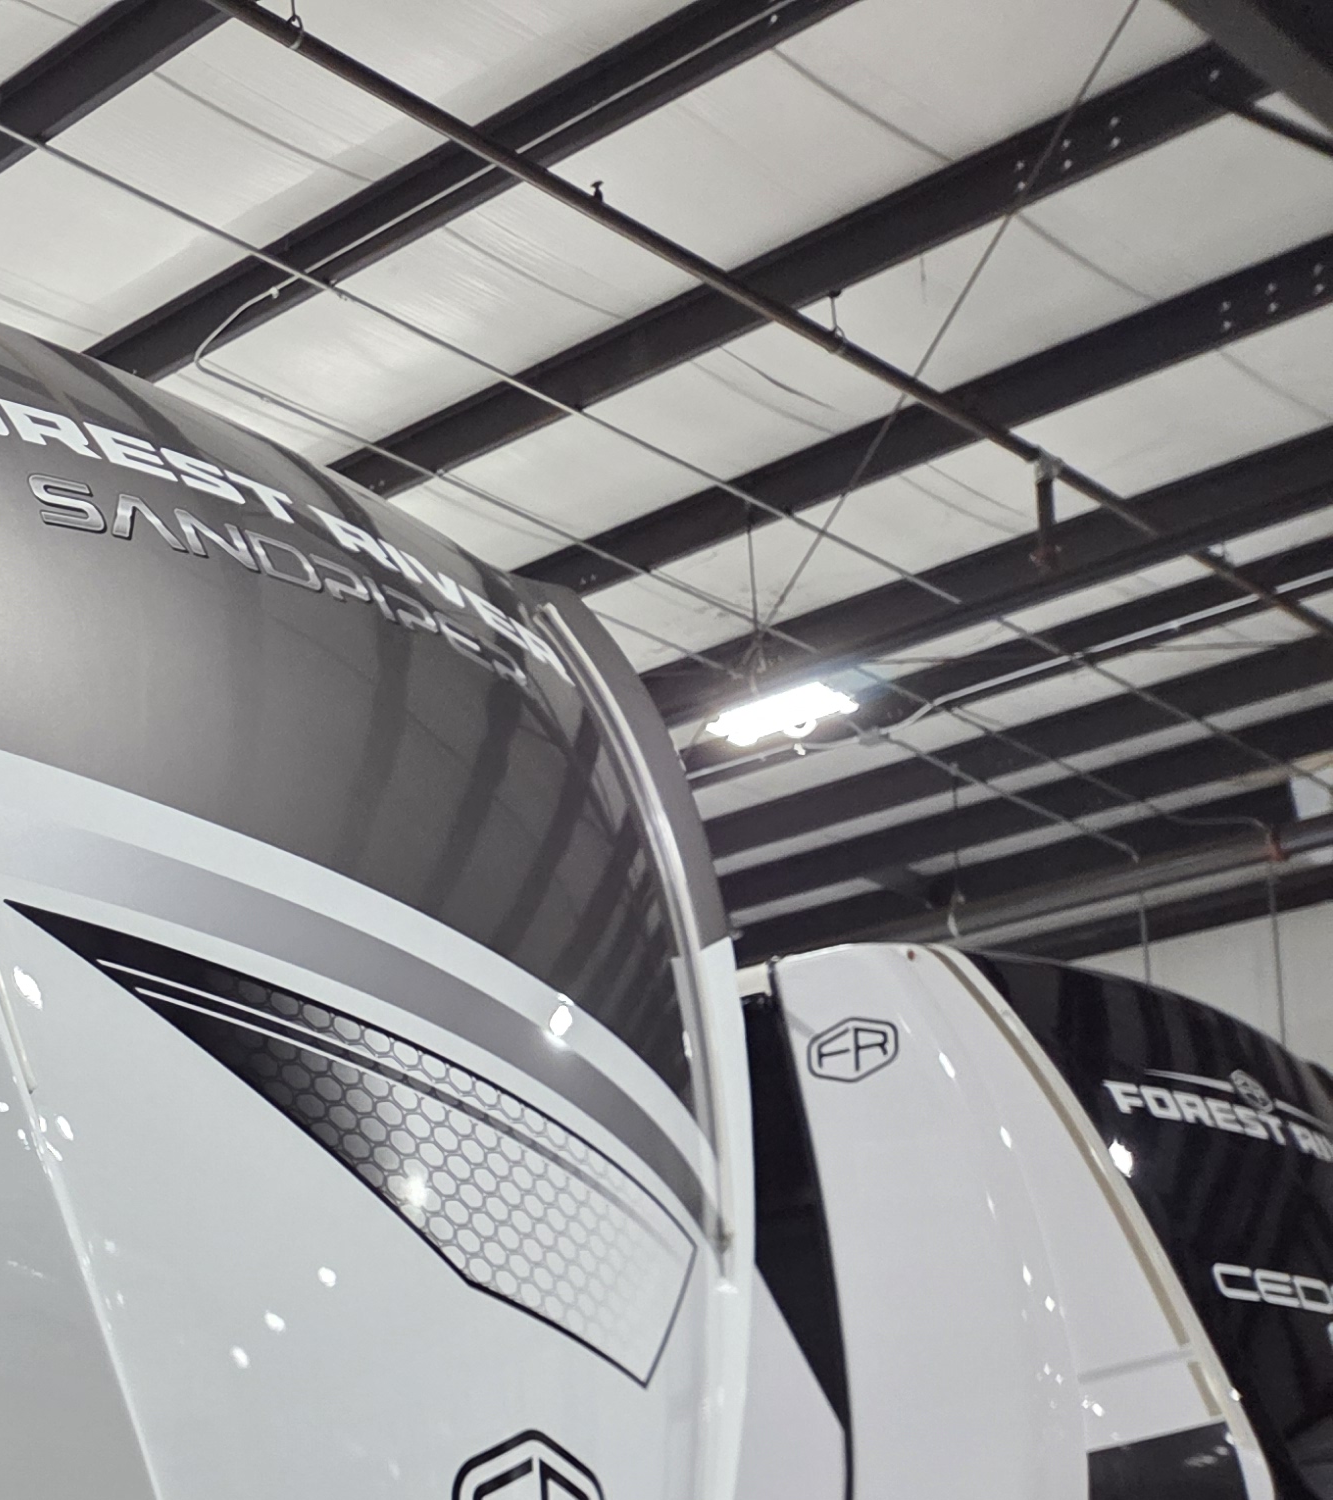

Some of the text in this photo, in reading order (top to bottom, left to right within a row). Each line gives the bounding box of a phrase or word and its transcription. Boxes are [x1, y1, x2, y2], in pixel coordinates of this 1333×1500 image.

[26, 473, 527, 687] SANDPIPER
[307, 504, 576, 686] RIVER
[1102, 1079, 1287, 1146] FOREST
[1212, 1262, 1333, 1315] CED
